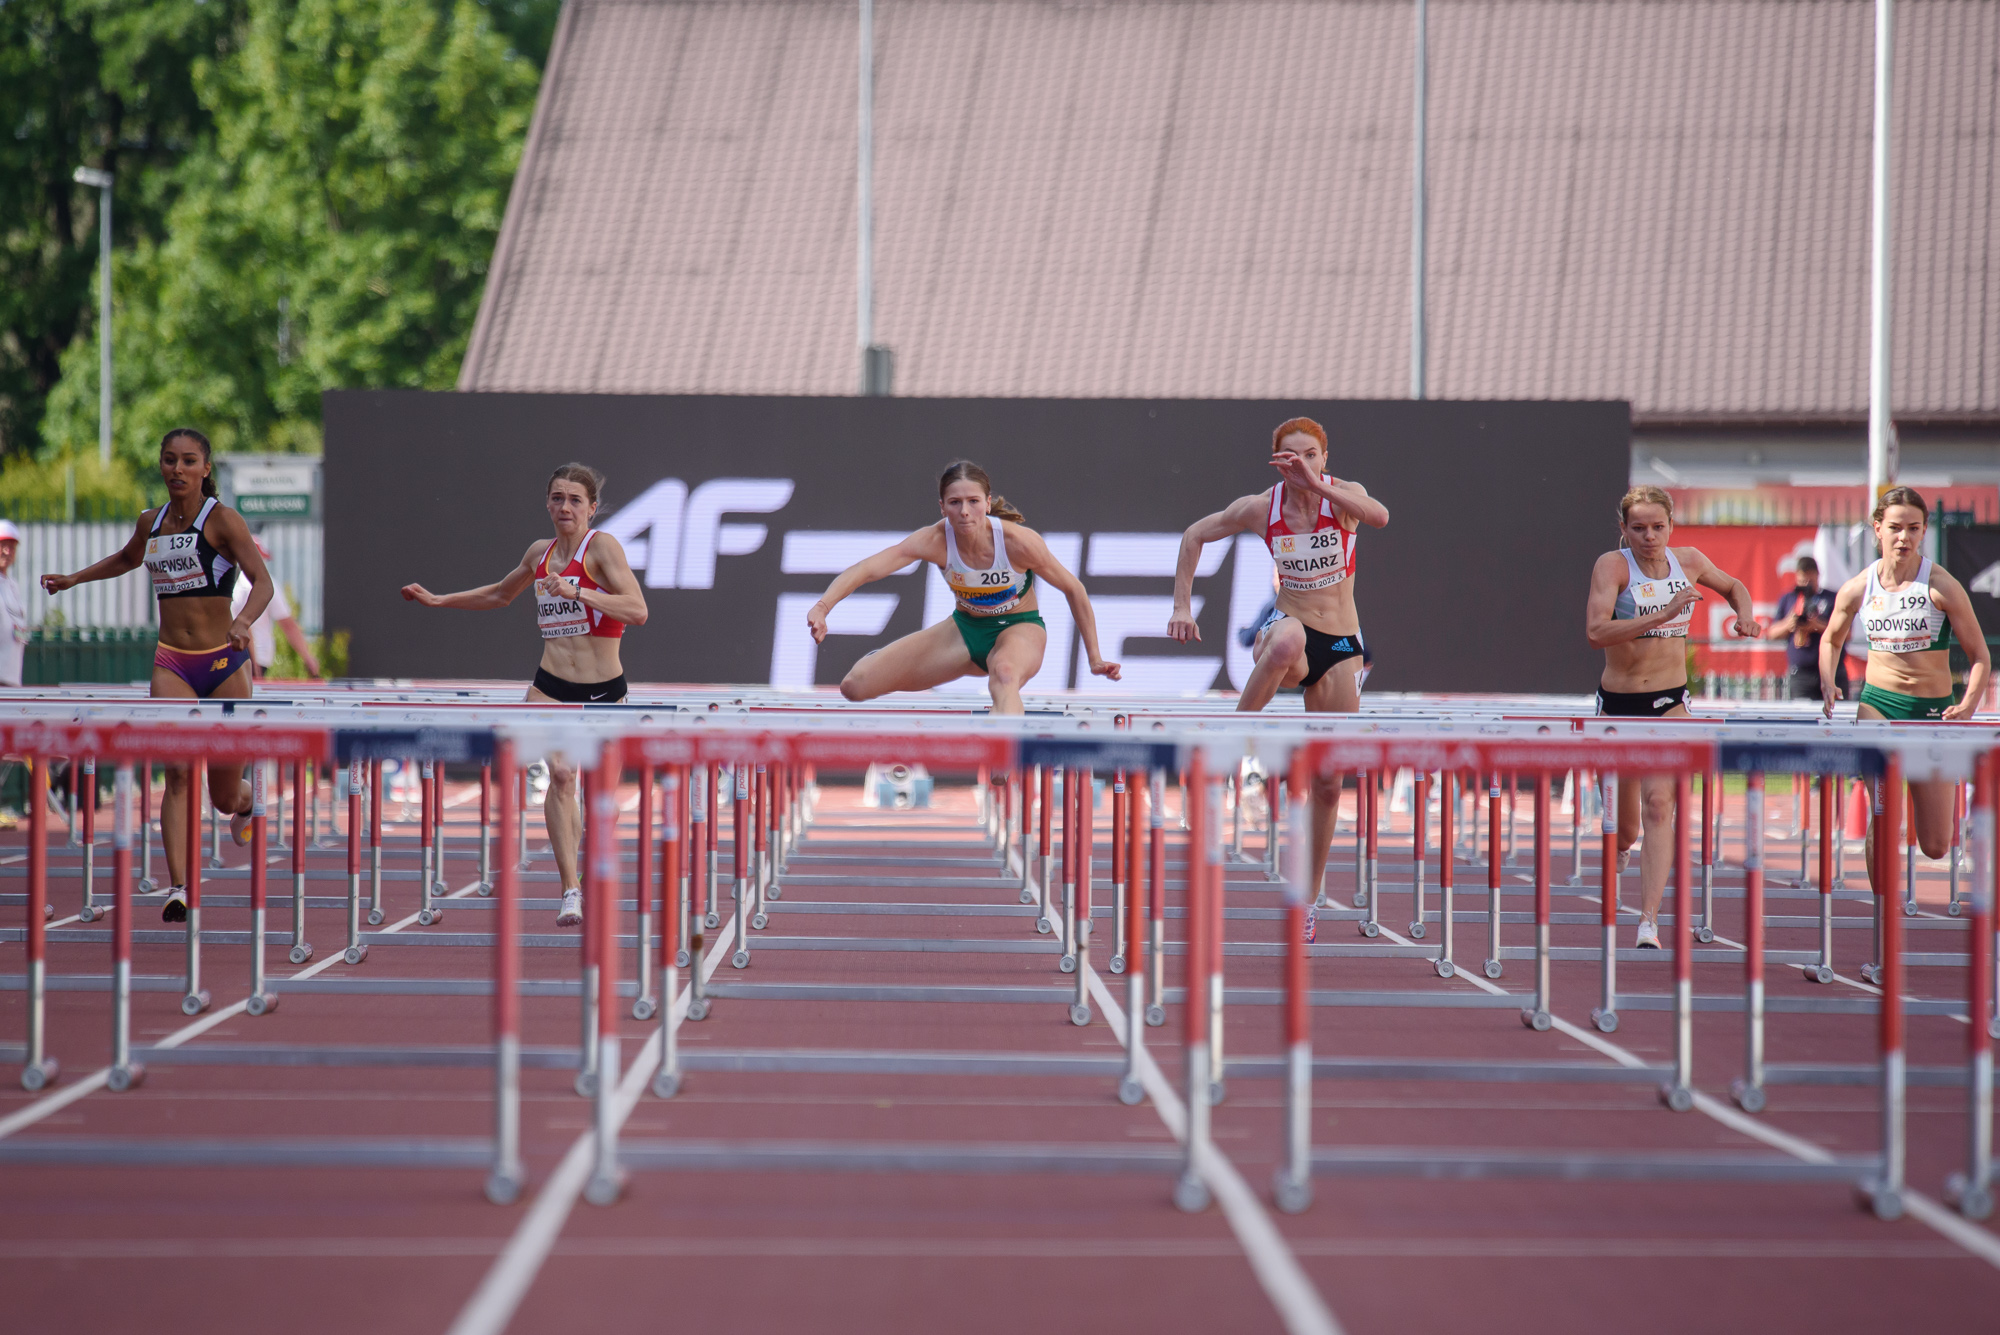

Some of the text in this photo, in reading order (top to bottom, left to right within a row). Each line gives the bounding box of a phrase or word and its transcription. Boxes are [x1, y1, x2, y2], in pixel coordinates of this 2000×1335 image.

[170, 536, 193, 550] 139
[1310, 532, 1338, 549] 285
[1282, 554, 1339, 572] SICIARZ
[980, 571, 1010, 585] 205
[1284, 576, 1336, 590] SUWAŁKI 2022
[177, 581, 195, 591] 2022
[1899, 596, 1926, 609] 199
[561, 626, 578, 635] 2022
[1867, 617, 1928, 631] ODOWSKA
[1902, 642, 1919, 651] 2022
[254, 768, 264, 805] polanik
[1605, 785, 1614, 822] polanik
